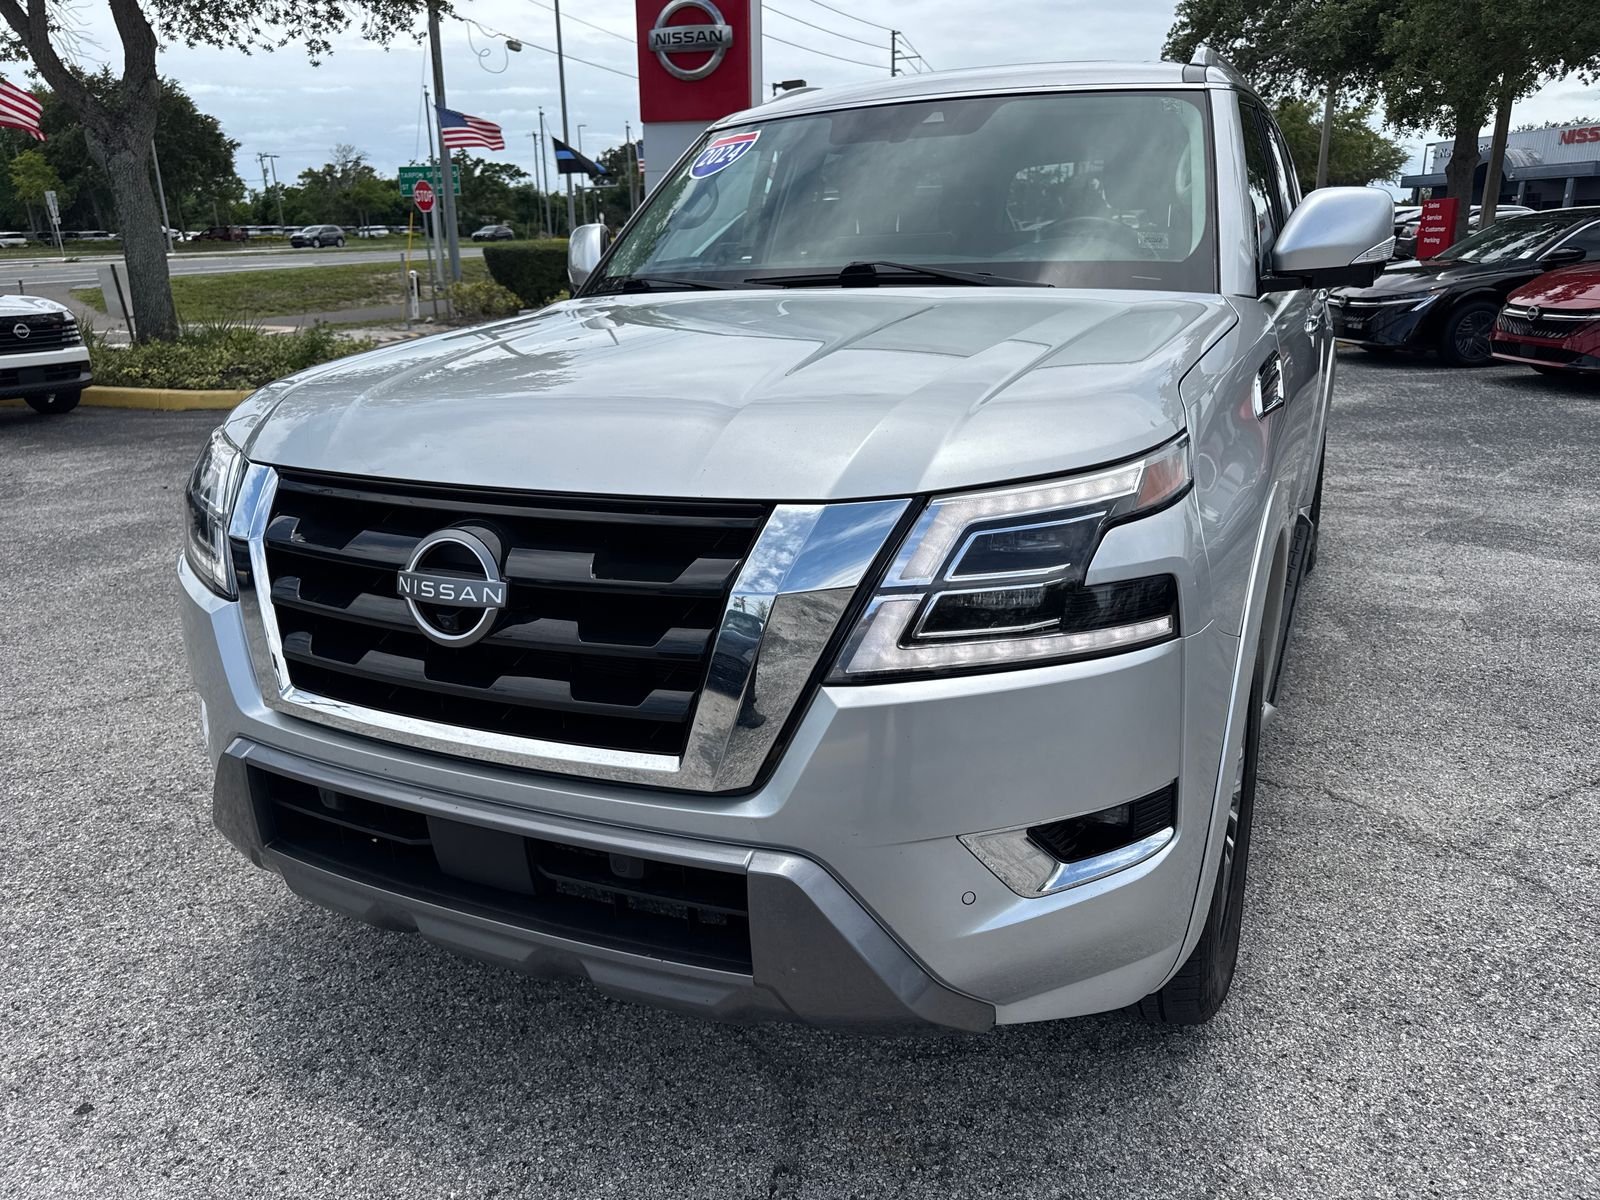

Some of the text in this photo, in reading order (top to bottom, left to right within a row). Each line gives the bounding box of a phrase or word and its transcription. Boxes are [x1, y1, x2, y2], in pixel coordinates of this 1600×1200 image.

[655, 30, 722, 45] NISSAN
[695, 142, 747, 168] 2024
[415, 190, 432, 202] STOP
[399, 576, 502, 603] NISSAN
